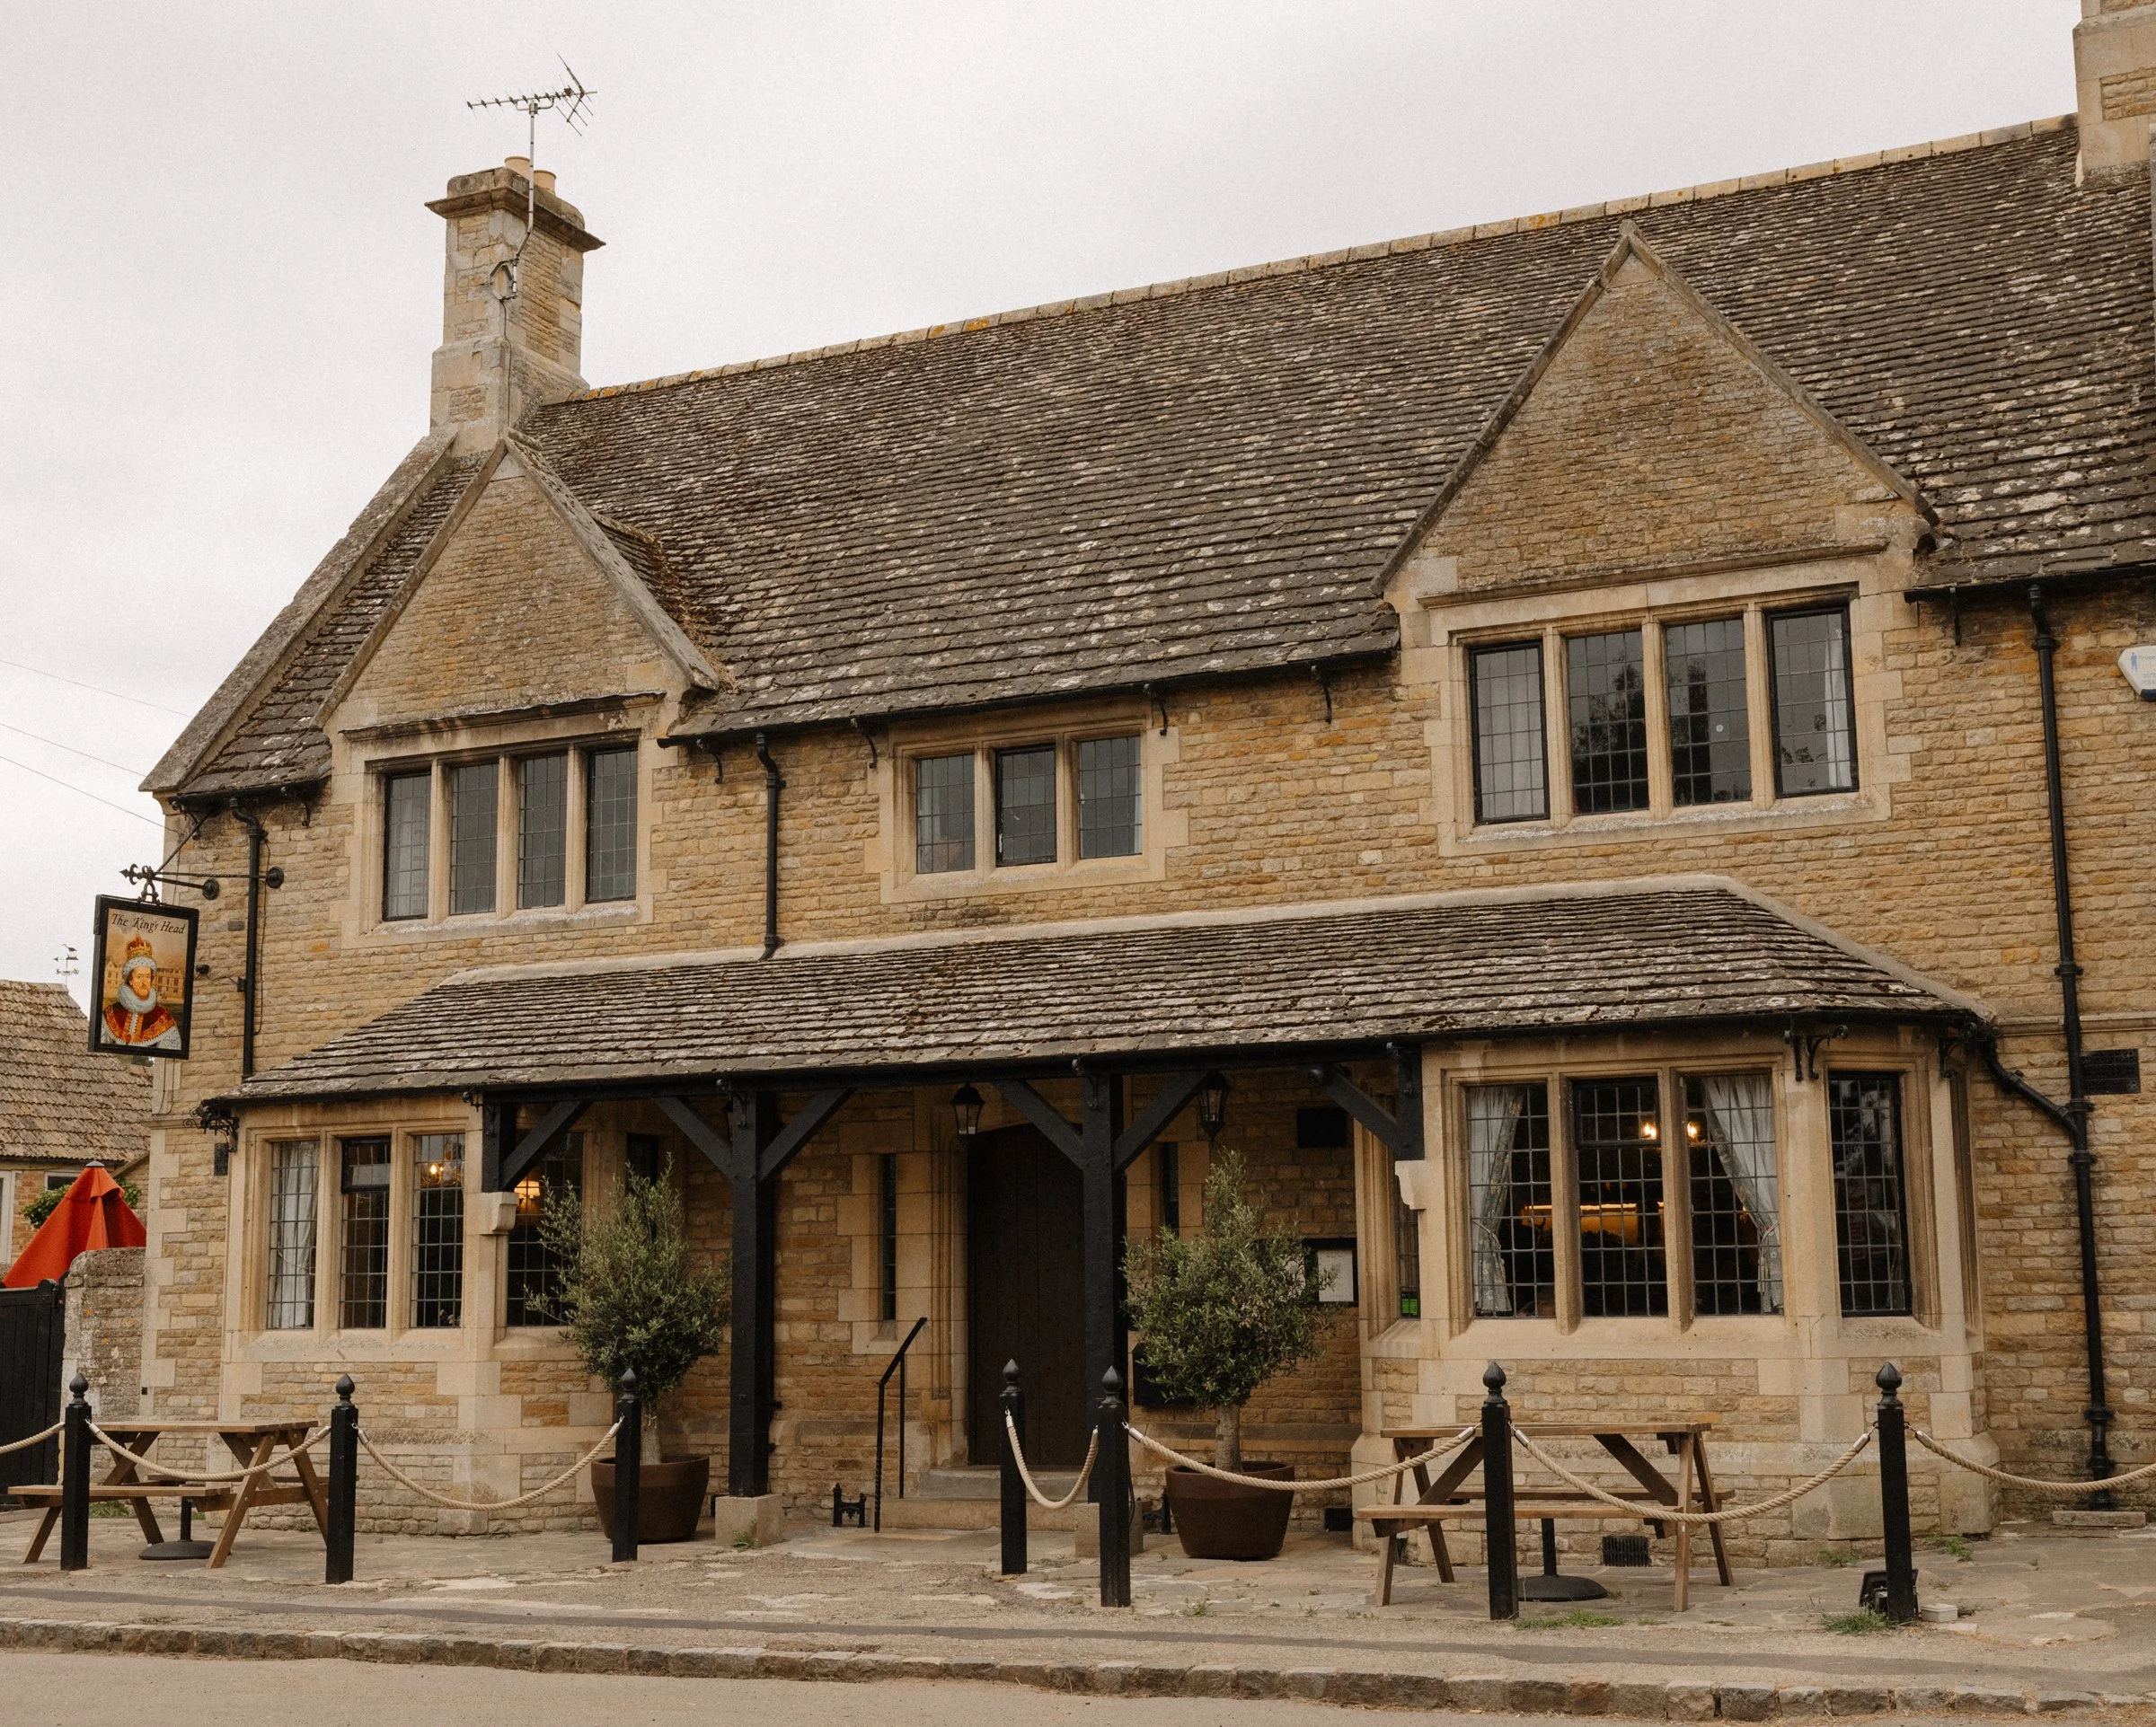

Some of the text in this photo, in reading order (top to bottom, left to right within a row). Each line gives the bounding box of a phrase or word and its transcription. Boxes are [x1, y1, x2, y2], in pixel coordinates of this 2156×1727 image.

[111, 913, 185, 934] The King's Head
